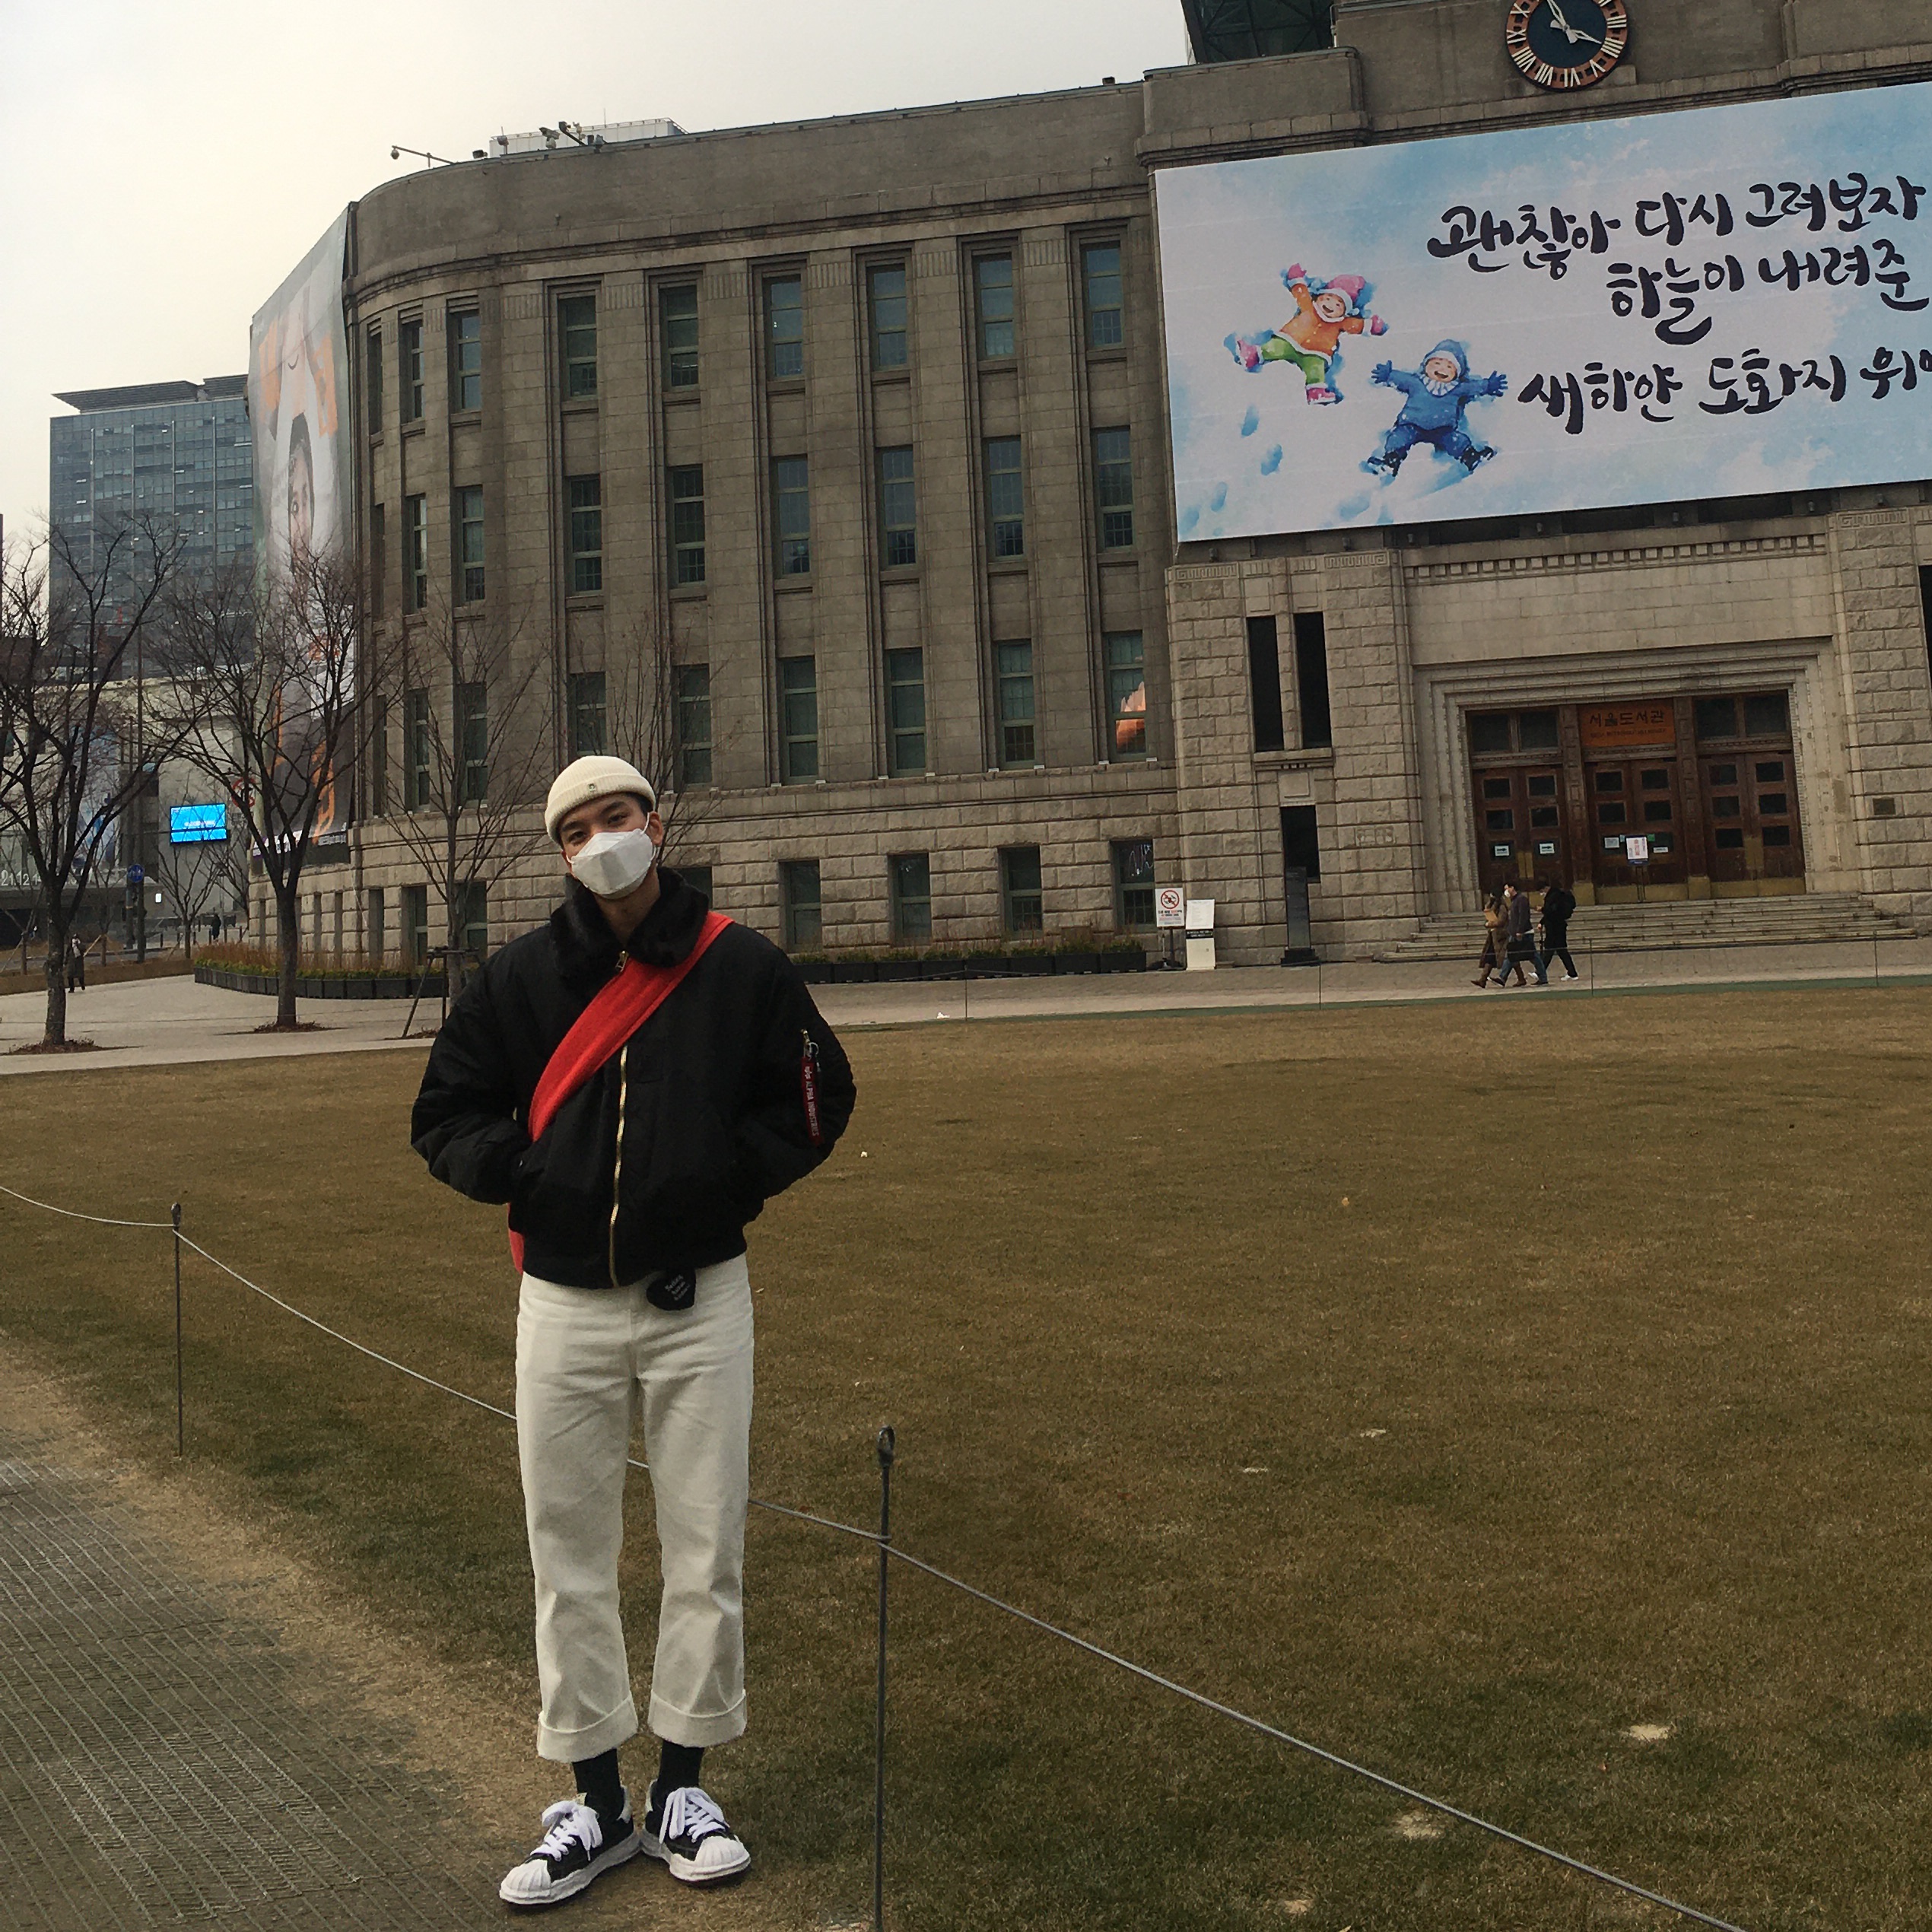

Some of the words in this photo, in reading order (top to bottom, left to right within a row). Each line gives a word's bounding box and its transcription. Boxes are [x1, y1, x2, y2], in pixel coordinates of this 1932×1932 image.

[1427, 205, 1621, 280] 괜찮아
[1635, 192, 1734, 246] 다시
[1745, 172, 1927, 232] 그려보자
[1606, 254, 1745, 345] 하늘이
[1758, 238, 1930, 312] 내려준
[1517, 362, 1683, 435] 새하얀
[1698, 348, 1847, 415] 도화지
[1589, 709, 1665, 728] 서울도서관
